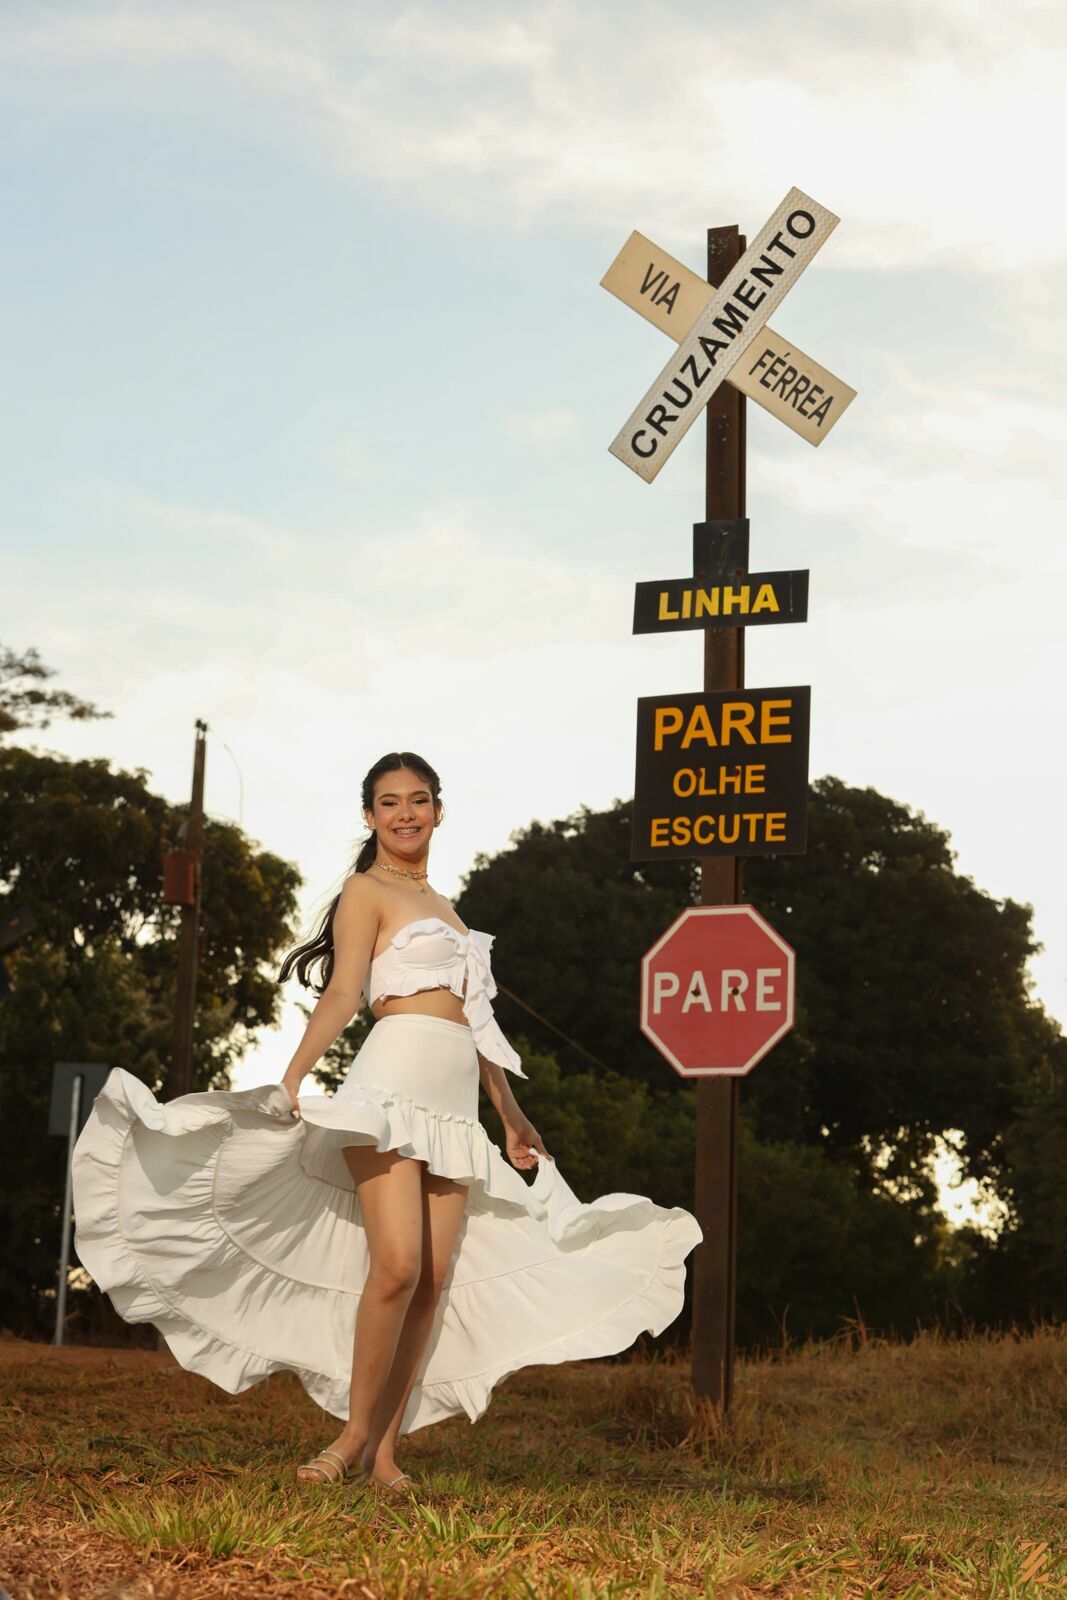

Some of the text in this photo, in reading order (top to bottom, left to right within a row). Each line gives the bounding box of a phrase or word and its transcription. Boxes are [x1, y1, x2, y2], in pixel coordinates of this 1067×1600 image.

[631, 209, 816, 459] CRUZAMENTO
[639, 262, 834, 427] VIA FÉRREA
[658, 583, 780, 621] LINHA
[654, 699, 792, 751] PARE
[672, 764, 766, 798] OLHE
[650, 812, 787, 847] ESCUTE
[653, 968, 782, 1014] PARE
